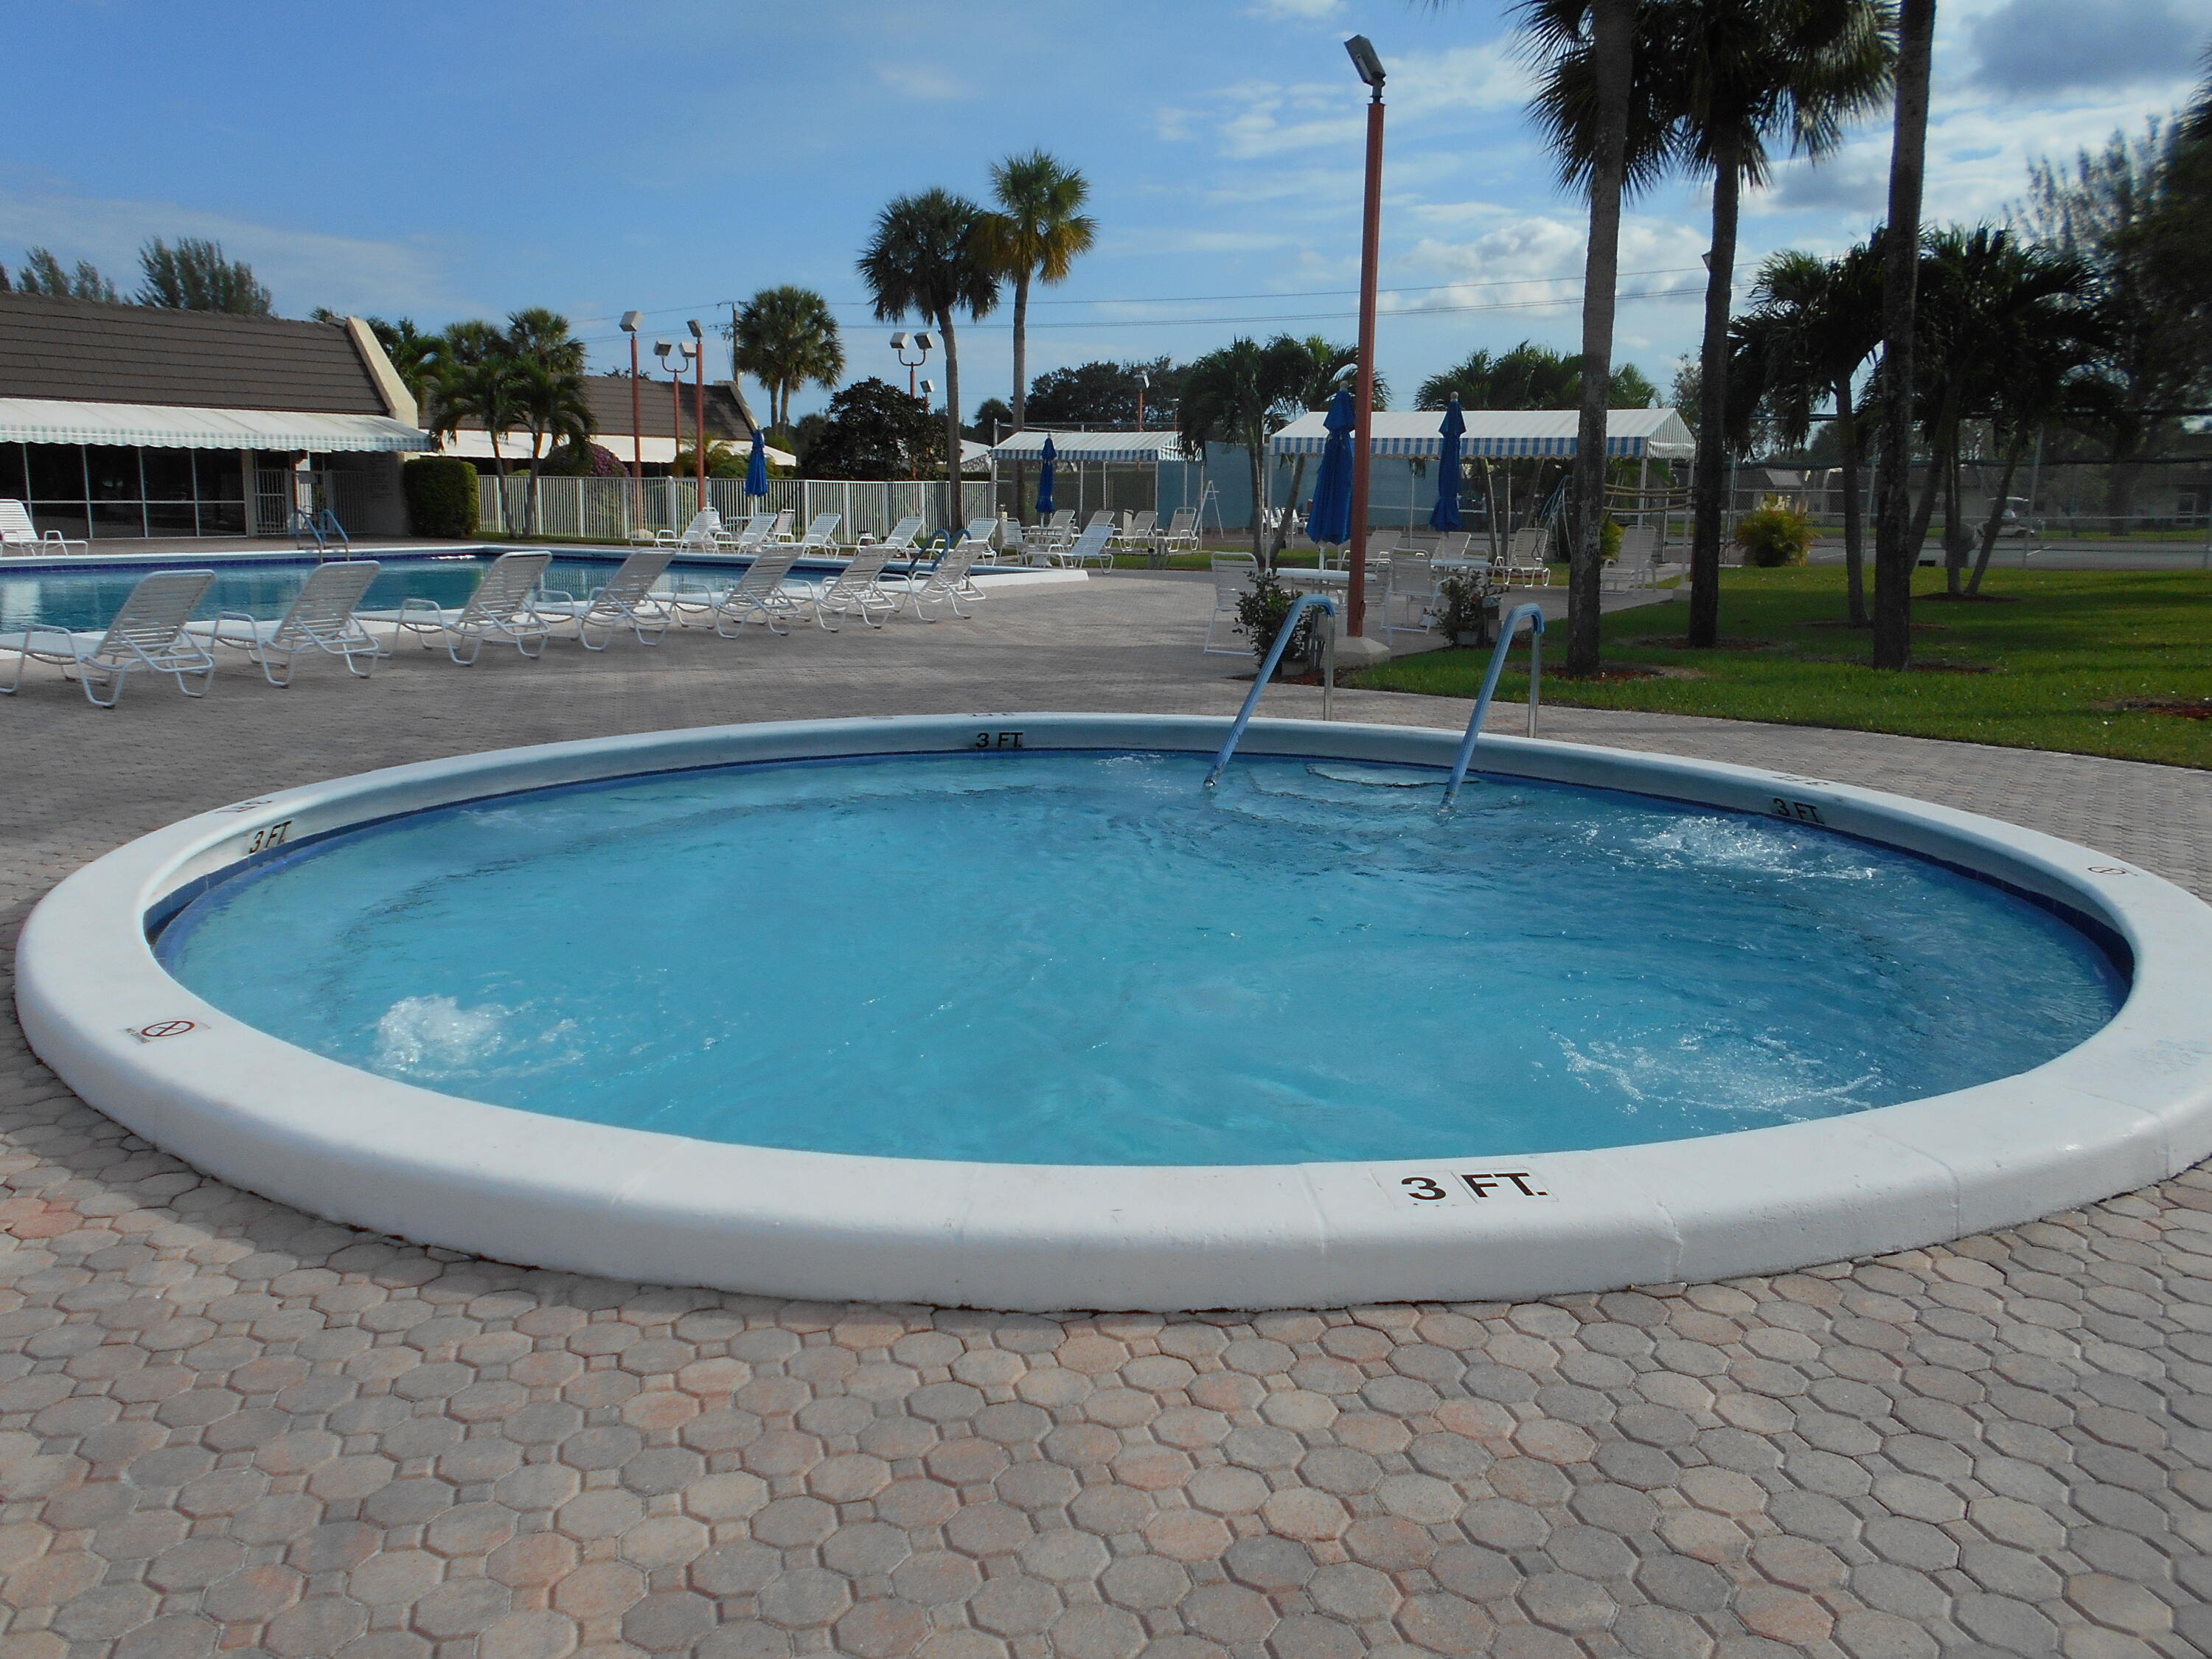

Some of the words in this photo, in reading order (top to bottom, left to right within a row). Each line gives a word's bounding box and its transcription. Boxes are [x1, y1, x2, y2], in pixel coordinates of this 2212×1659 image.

[975, 732, 990, 748] 3
[998, 731, 1023, 748] FT.
[1773, 798, 1790, 816] 3
[248, 830, 264, 854] 3
[1401, 1177, 1447, 1200] 3
[1461, 1172, 1548, 1198] FT.
